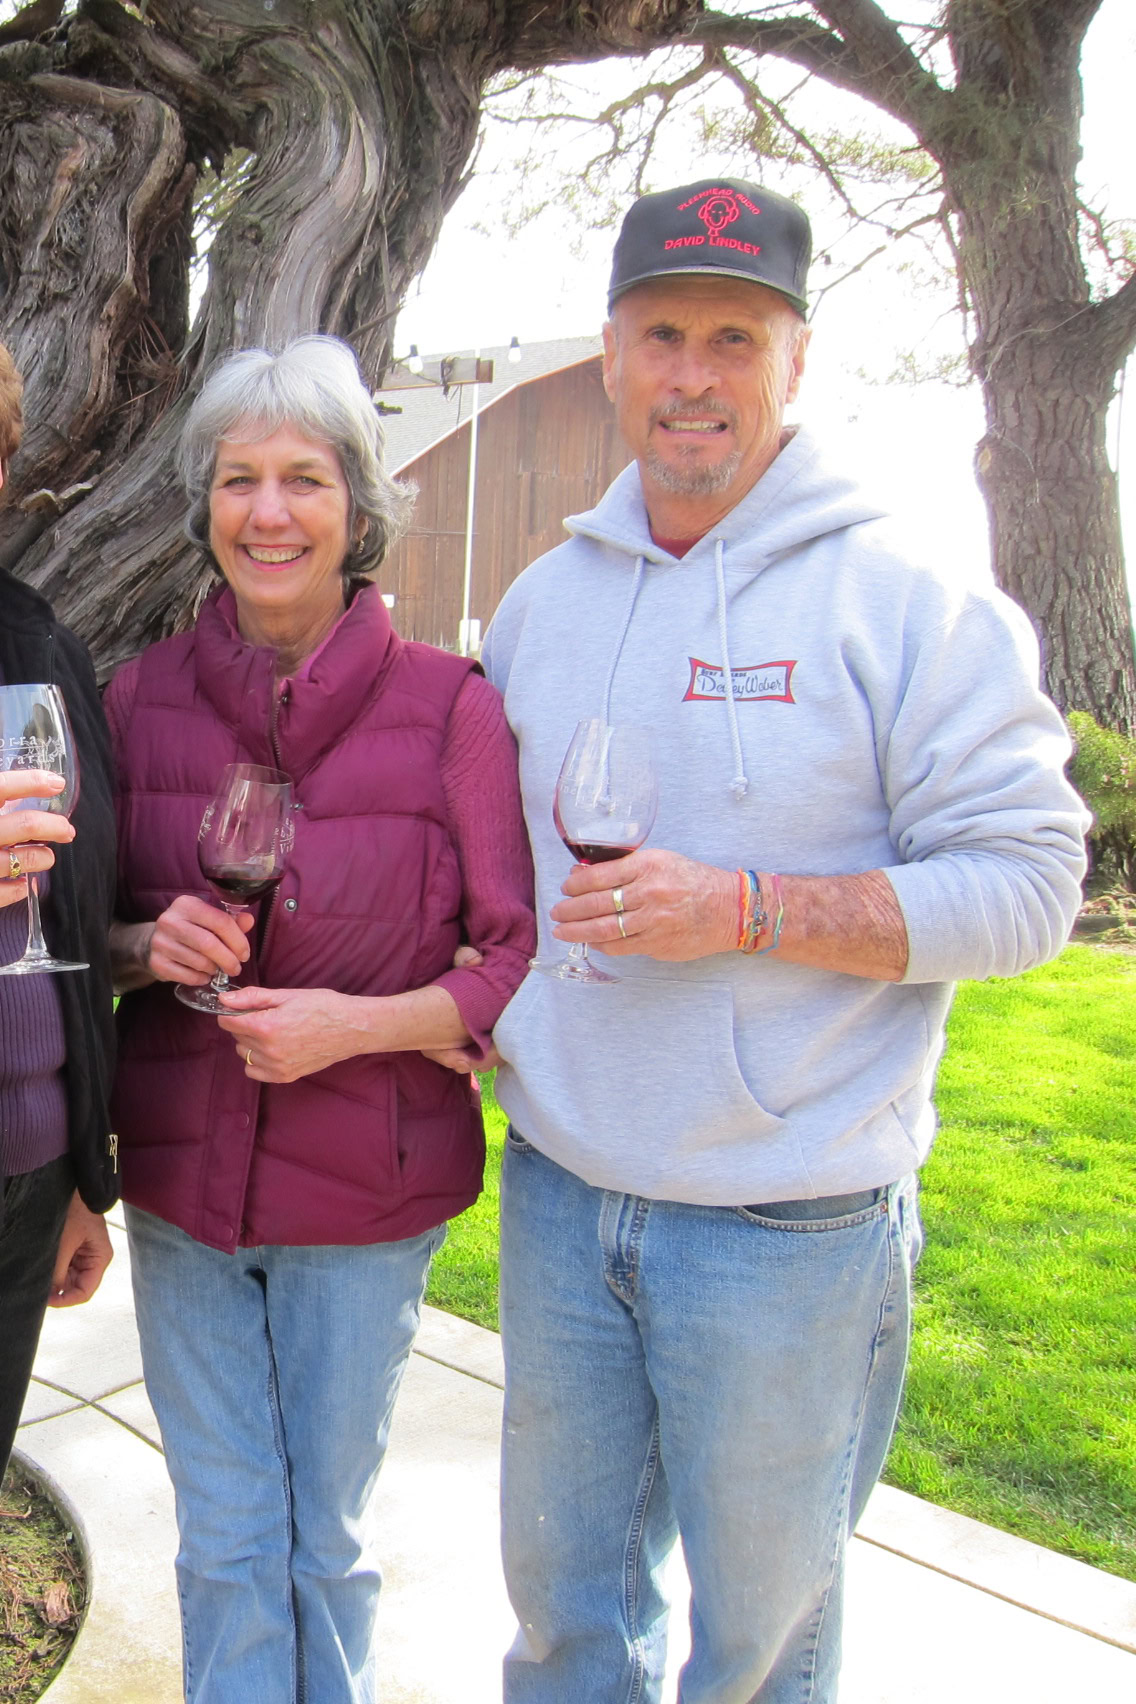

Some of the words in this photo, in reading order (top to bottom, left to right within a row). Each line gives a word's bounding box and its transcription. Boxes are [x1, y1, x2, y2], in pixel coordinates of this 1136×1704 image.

[735, 193, 761, 215] AUDIO
[664, 236, 705, 250] DAVID
[709, 236, 761, 256] LINDLEY
[696, 674, 745, 697] Deey
